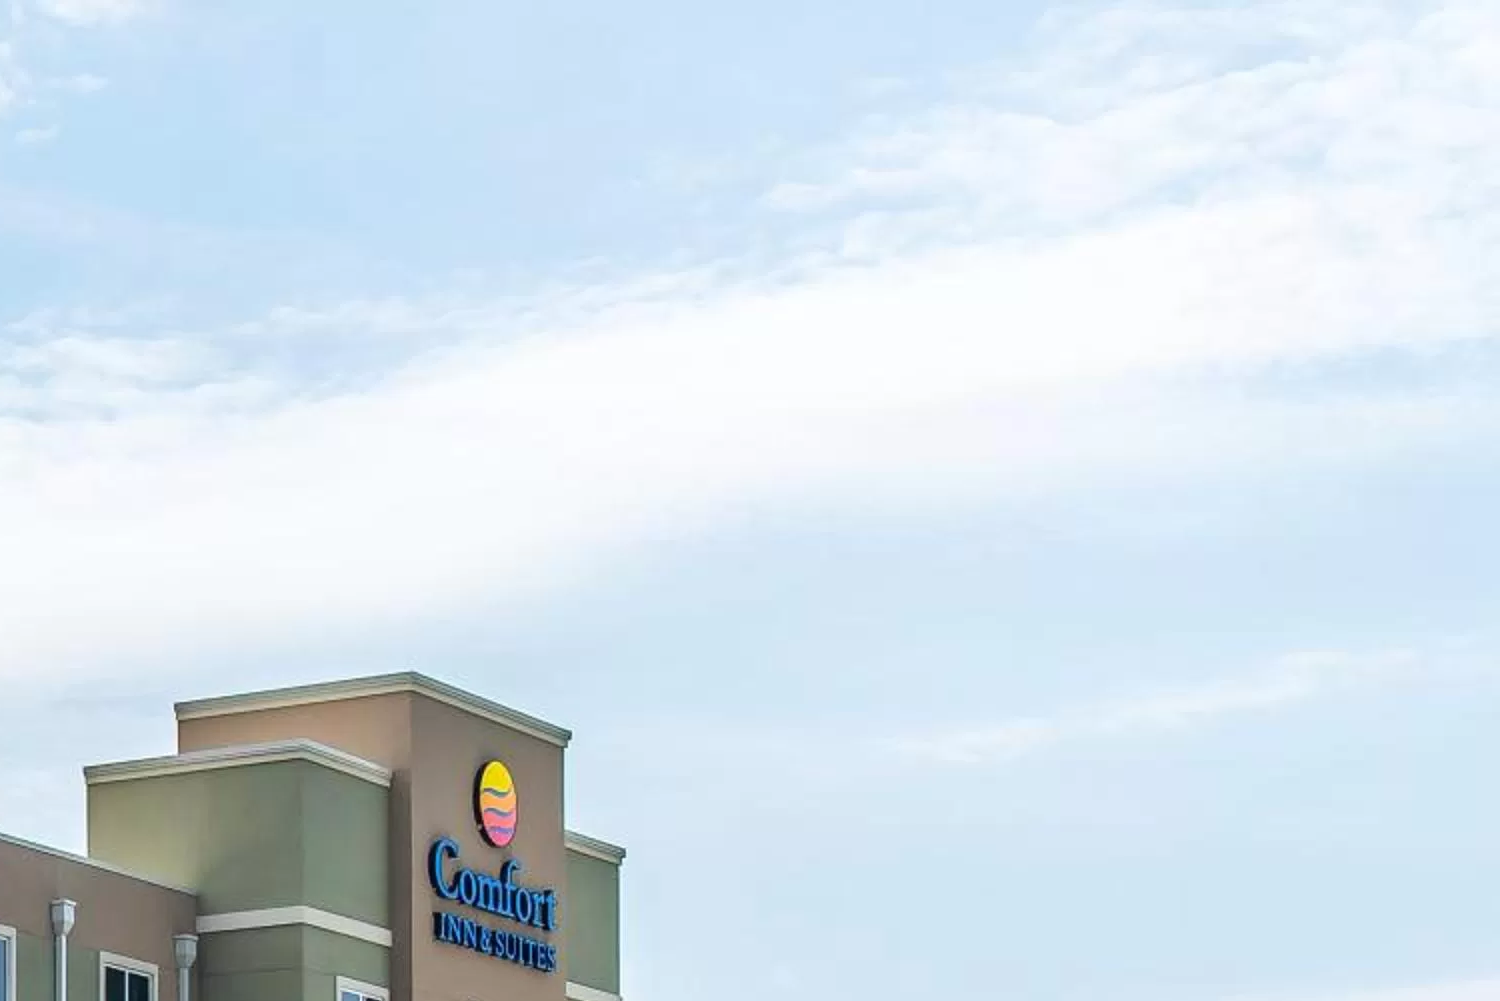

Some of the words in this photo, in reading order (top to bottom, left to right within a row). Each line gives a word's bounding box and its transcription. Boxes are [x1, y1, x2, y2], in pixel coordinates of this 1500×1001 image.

[428, 836, 557, 930] Comfort
[432, 911, 477, 950] INN
[494, 931, 557, 973] SUITES
